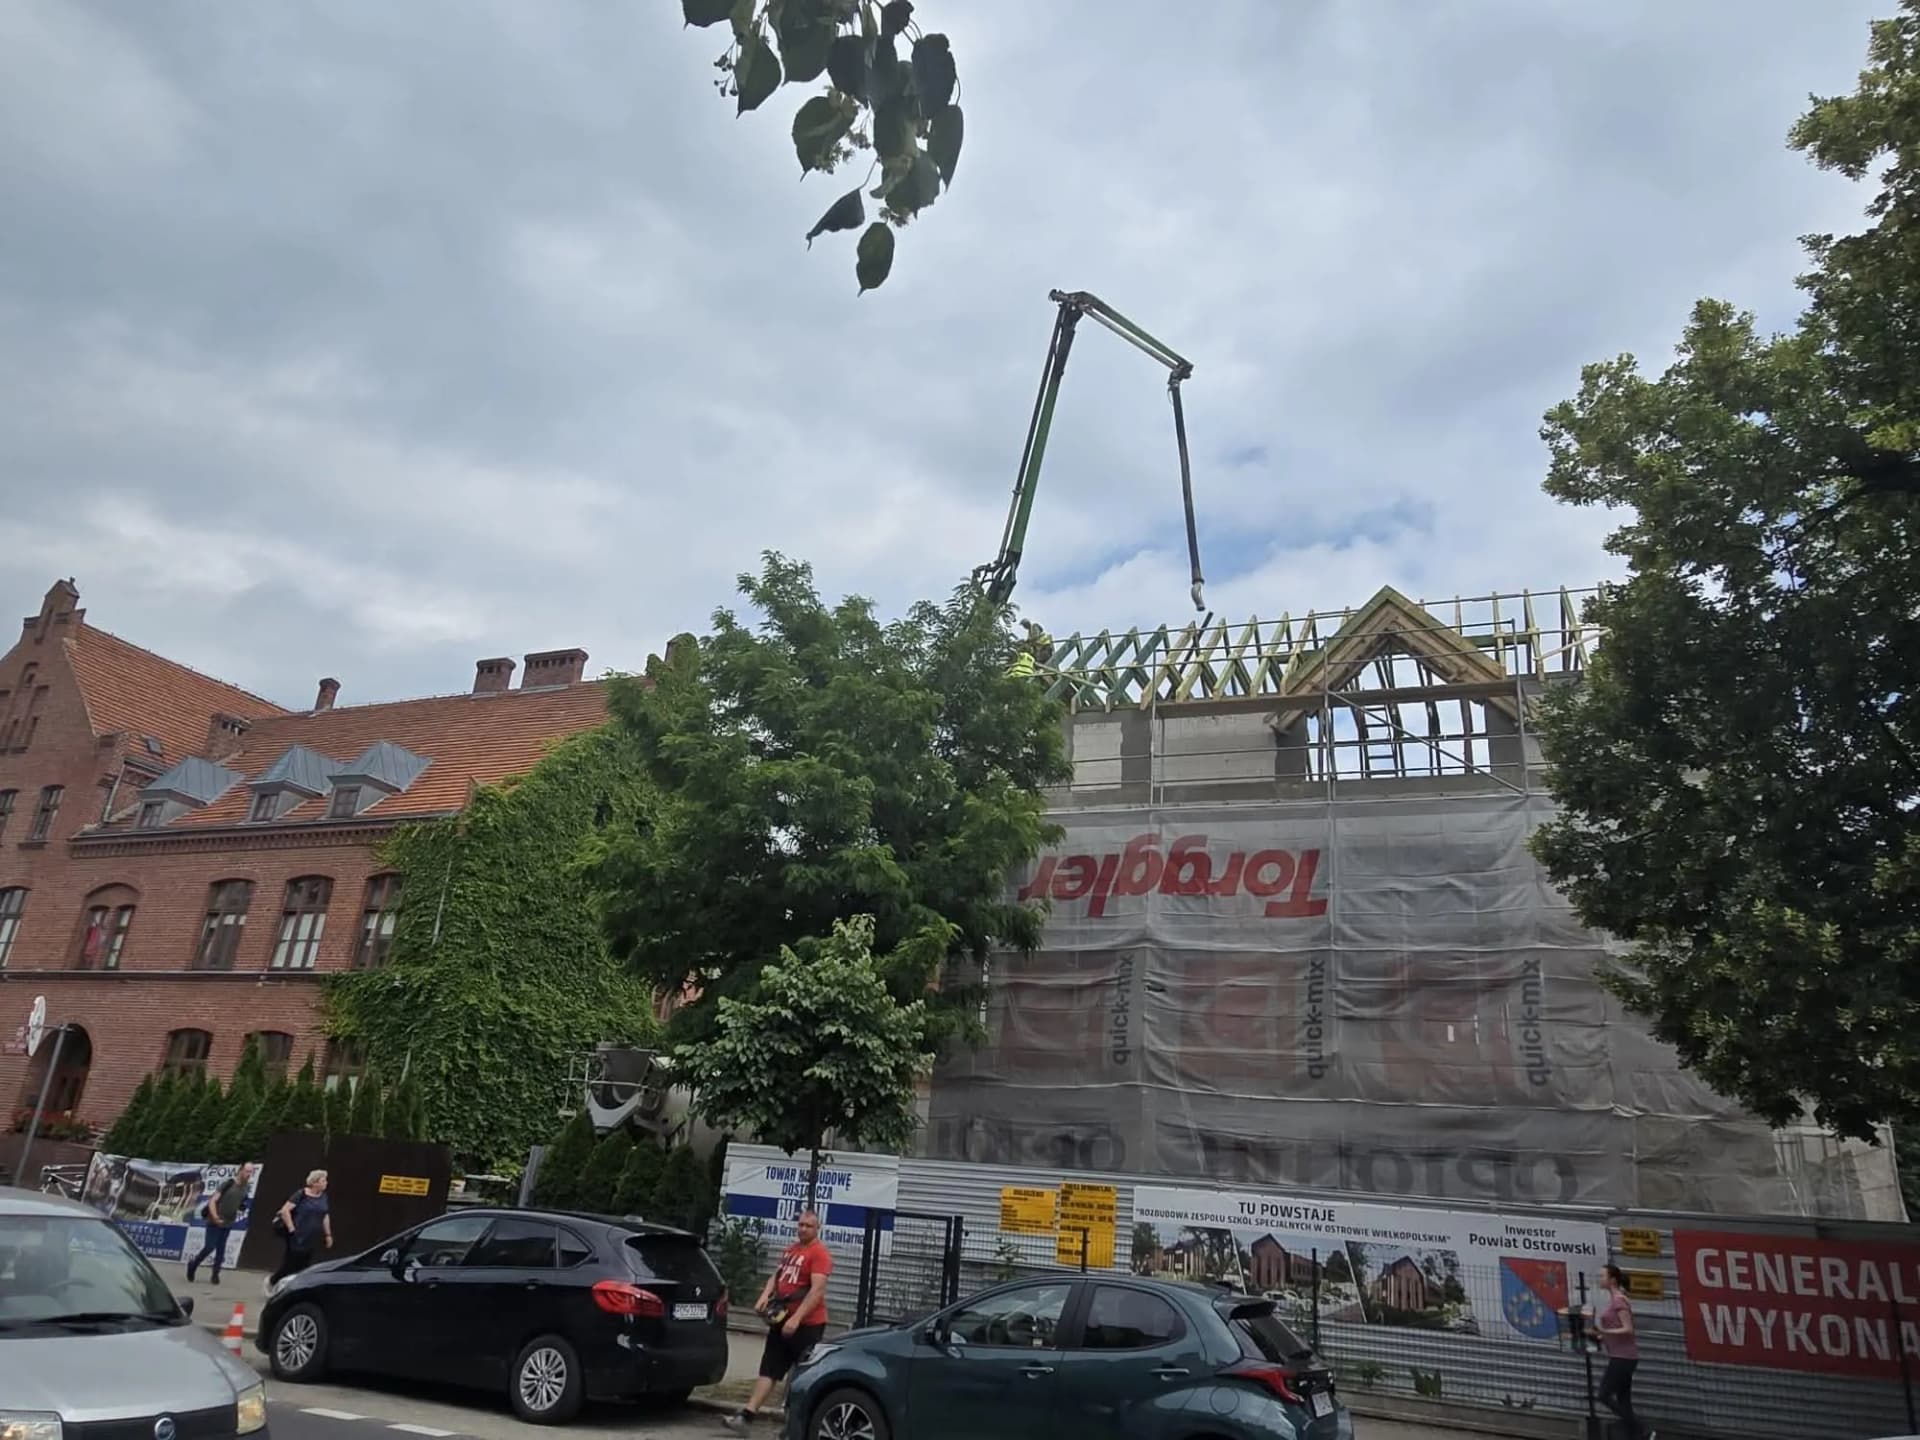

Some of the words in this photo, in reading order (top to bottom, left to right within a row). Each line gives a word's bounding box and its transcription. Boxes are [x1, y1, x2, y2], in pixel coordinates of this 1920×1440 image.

[1018, 833, 1328, 920] Torggler
[1109, 952, 1135, 1065] quick-mix
[1302, 959, 1329, 1080] quick-mix
[1517, 960, 1552, 1087] quick-mix
[766, 1166, 797, 1181] TOWAR
[781, 1183, 833, 1200] DOSTACZA
[1239, 1201, 1256, 1215] TU
[1260, 1203, 1336, 1222] POWSTAJE
[1255, 1218, 1312, 1232] SPECJALNYCH
[1313, 1224, 1323, 1233] W
[1325, 1225, 1369, 1237] OSTROWIE
[1505, 1224, 1556, 1238] Inwestor
[1469, 1233, 1519, 1249] Powiat
[1522, 1238, 1596, 1256] Ostrowski
[1695, 1248, 1920, 1305] GENERAL
